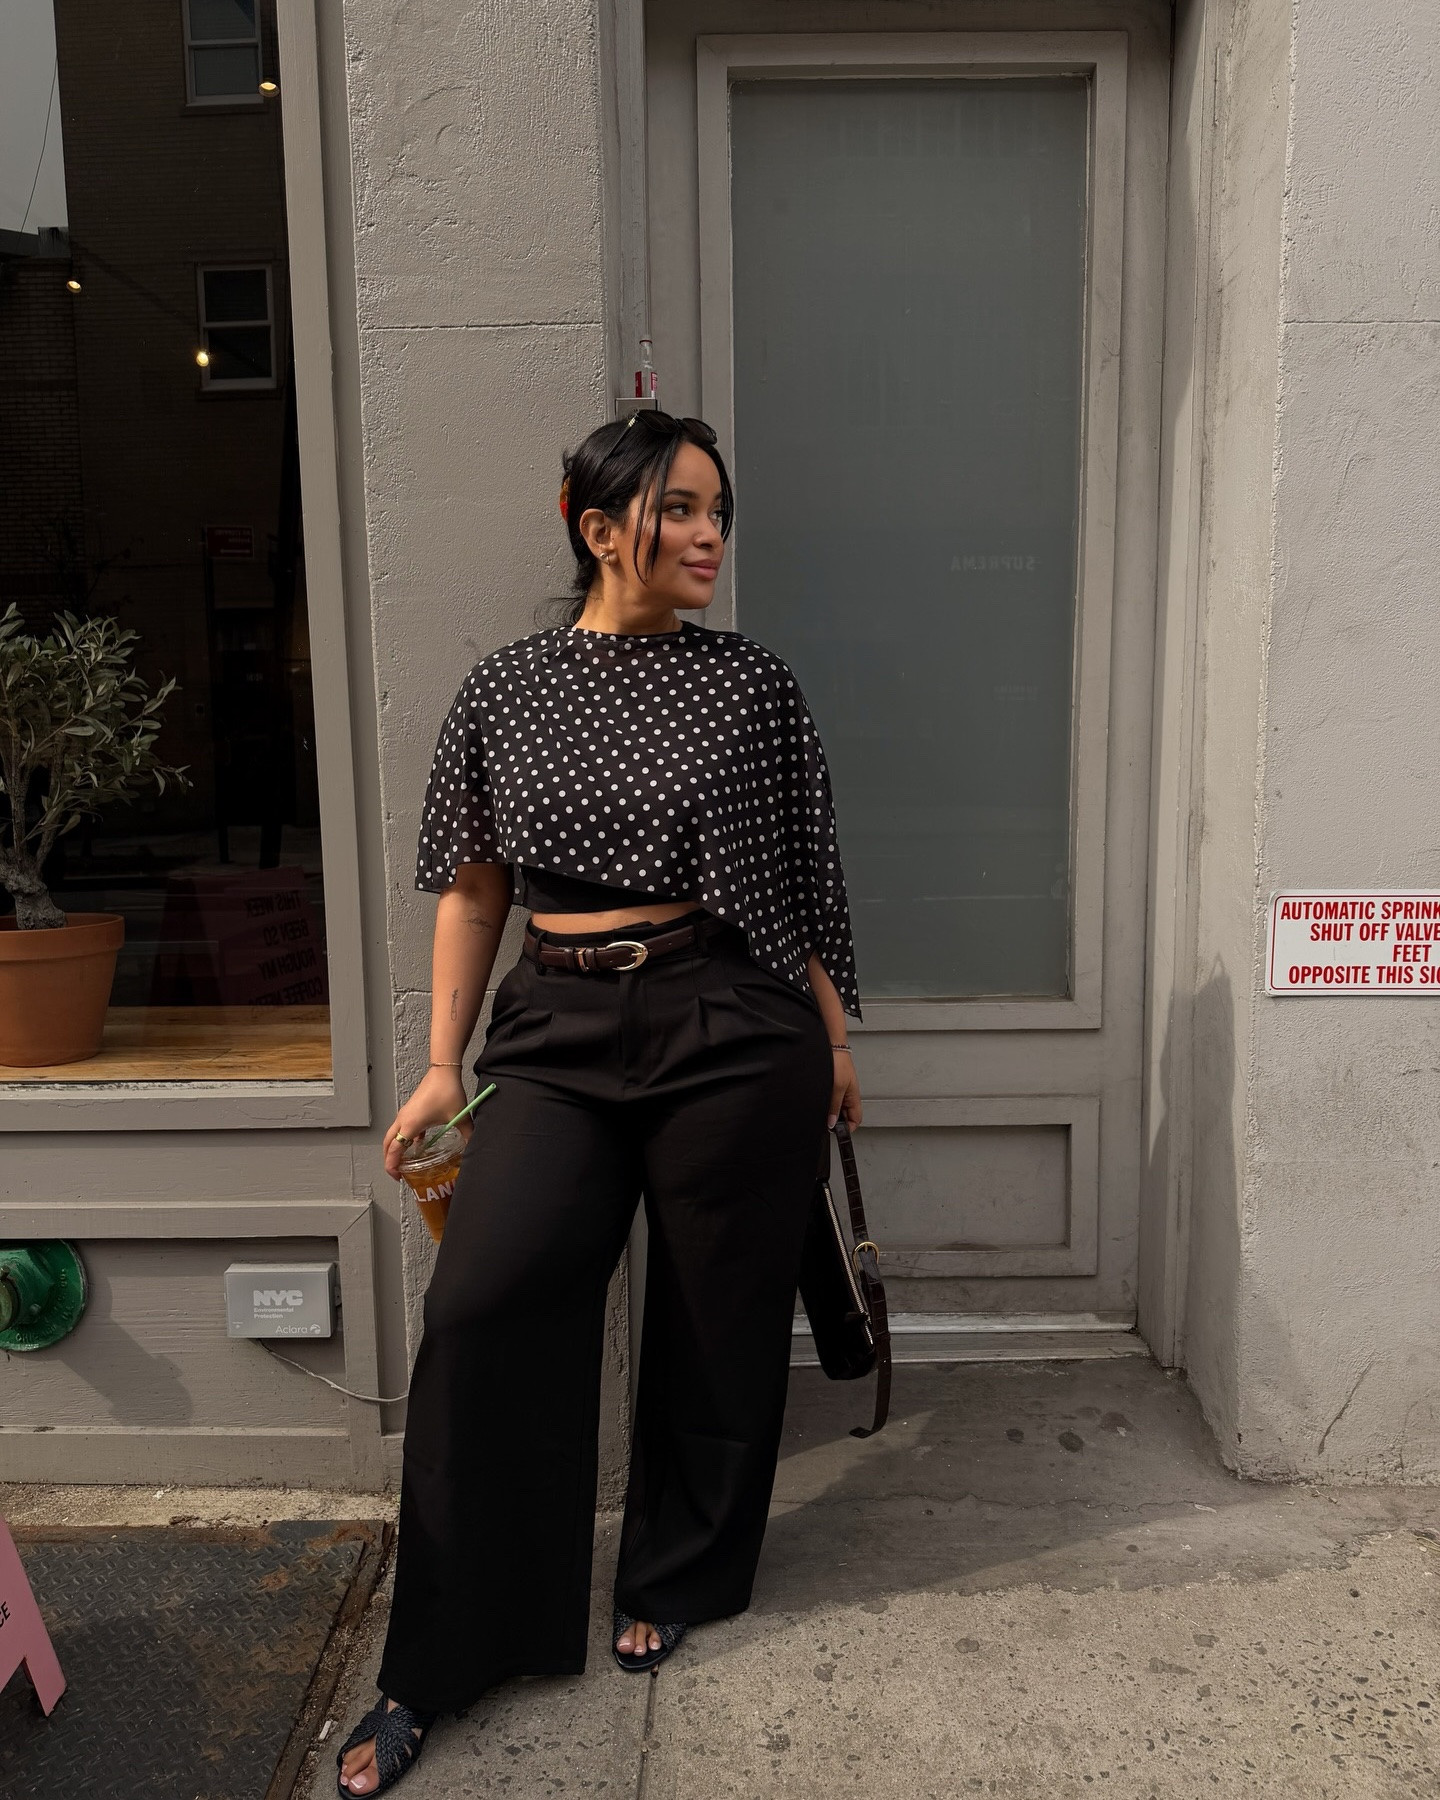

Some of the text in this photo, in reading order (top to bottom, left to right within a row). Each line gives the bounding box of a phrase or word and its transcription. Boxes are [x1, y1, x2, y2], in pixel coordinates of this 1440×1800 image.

[1280, 901, 1376, 920] AUTOMATIC
[1310, 923, 1440, 941] SHUT OFF VALVE
[1392, 944, 1432, 962] FEET
[1288, 965, 1371, 984] OPPOSITE
[1376, 965, 1414, 984] THIS
[413, 1179, 456, 1202] LAN
[253, 1290, 303, 1306] NYC
[275, 1325, 308, 1334] Aclara
